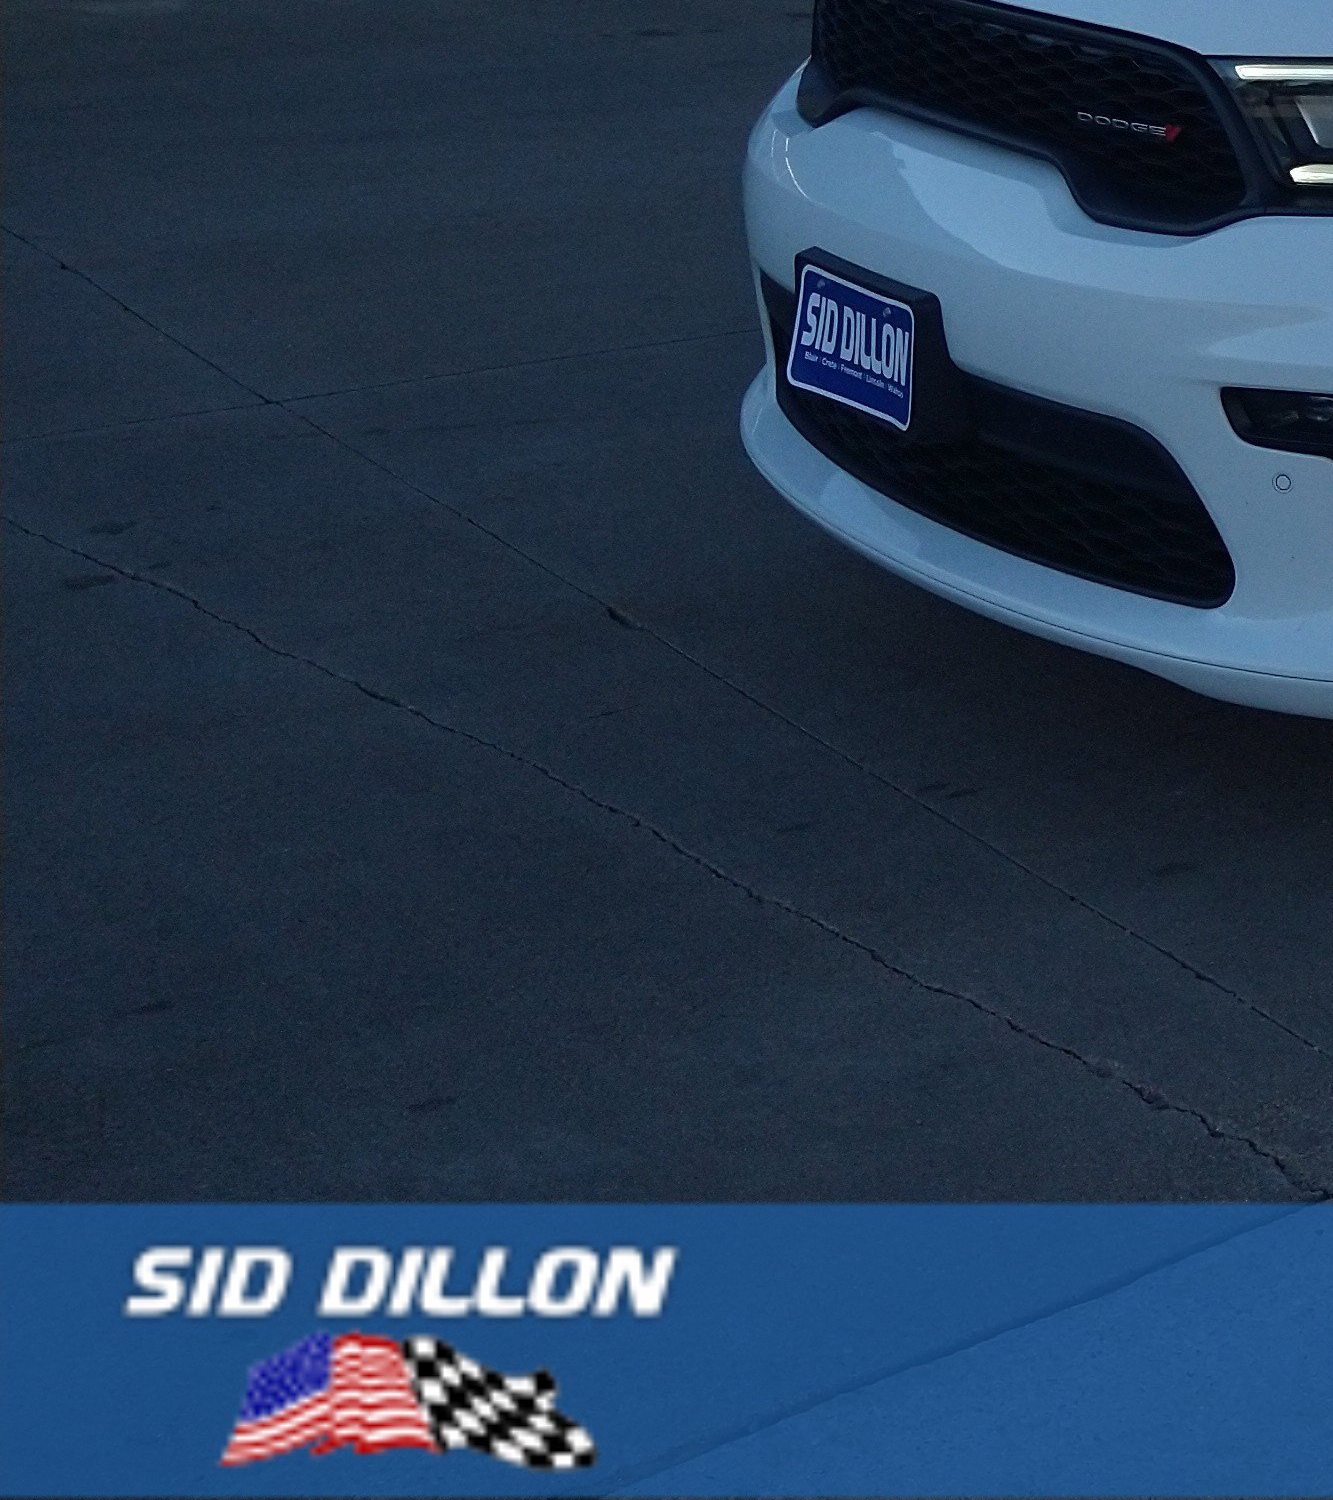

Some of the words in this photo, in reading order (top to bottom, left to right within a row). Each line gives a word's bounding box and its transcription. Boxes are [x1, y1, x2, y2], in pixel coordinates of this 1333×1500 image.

[1077, 111, 1167, 136] DODGE
[800, 292, 838, 355] SID
[839, 305, 910, 387] DILLON
